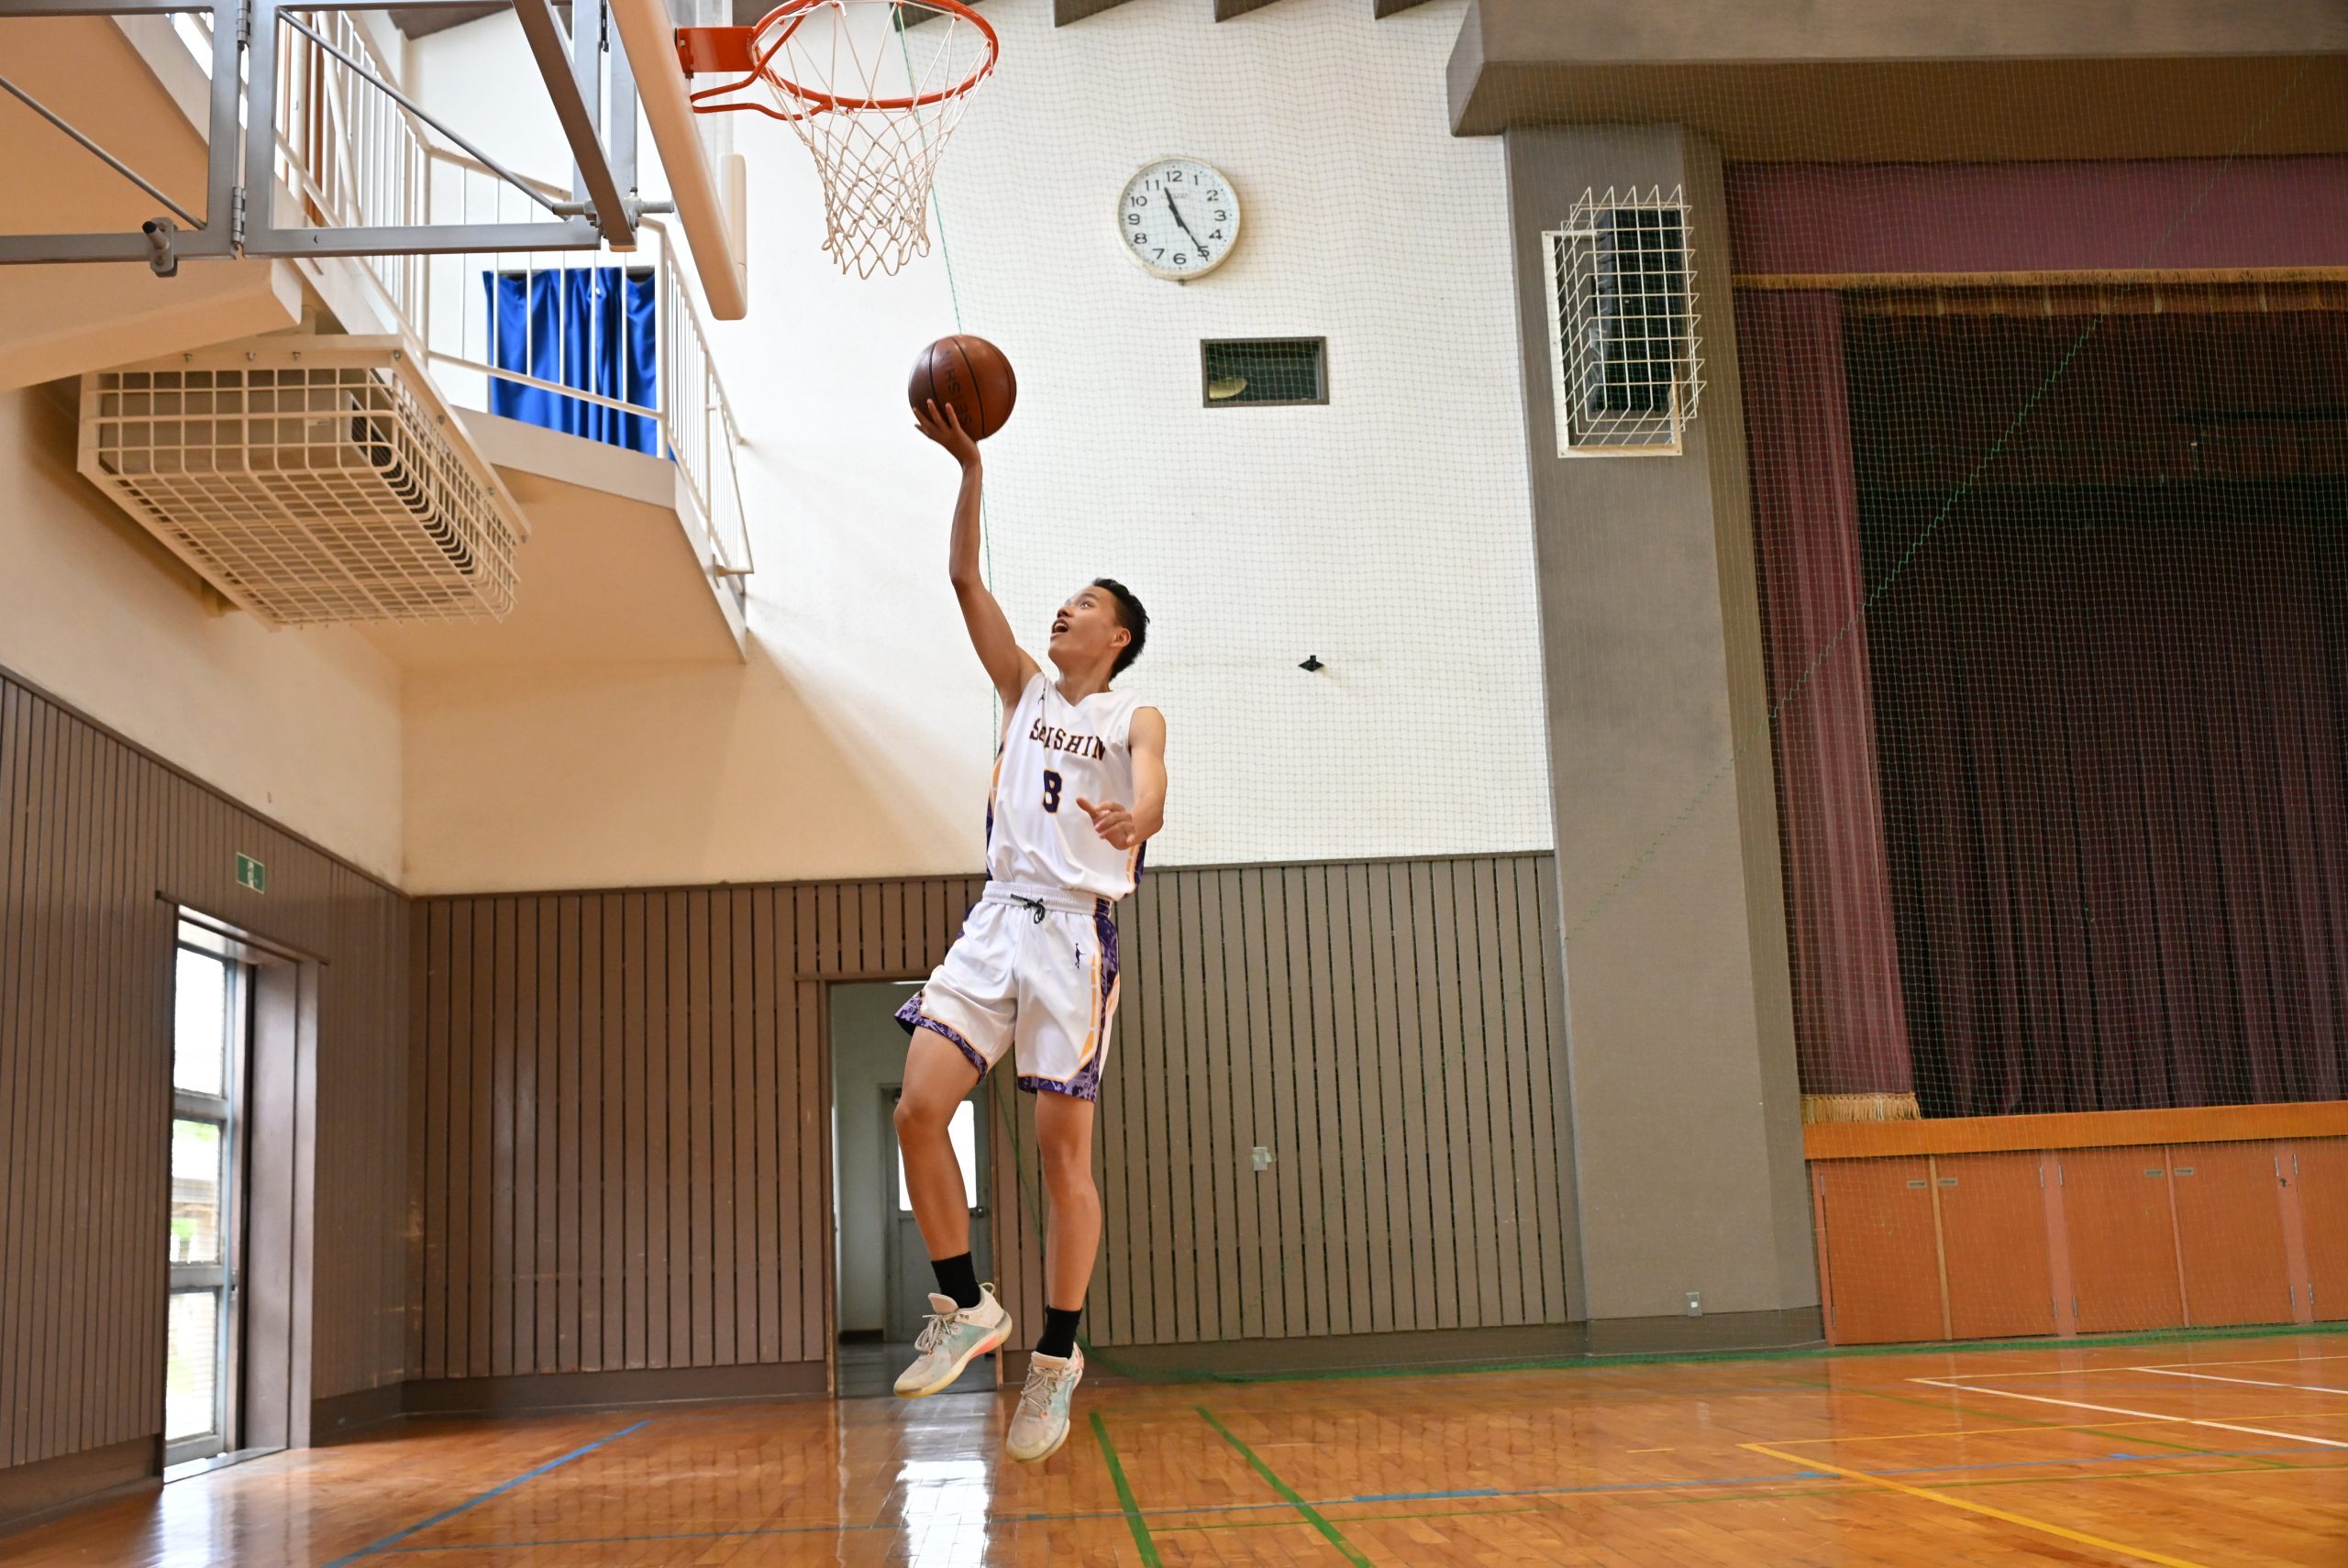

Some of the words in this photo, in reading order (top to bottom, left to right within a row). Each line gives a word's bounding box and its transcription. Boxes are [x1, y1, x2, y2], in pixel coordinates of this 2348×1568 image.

[1166, 171, 1182, 182] 12
[1145, 179, 1159, 191] 11
[1130, 195, 1147, 207] 10
[1206, 190, 1219, 202] 2
[1128, 213, 1140, 225] 9
[1214, 209, 1226, 222] 3
[1134, 233, 1147, 244] 8
[1209, 228, 1223, 240] 4
[1152, 248, 1165, 259] 7
[1197, 246, 1210, 258] 5
[1173, 253, 1187, 265] 6
